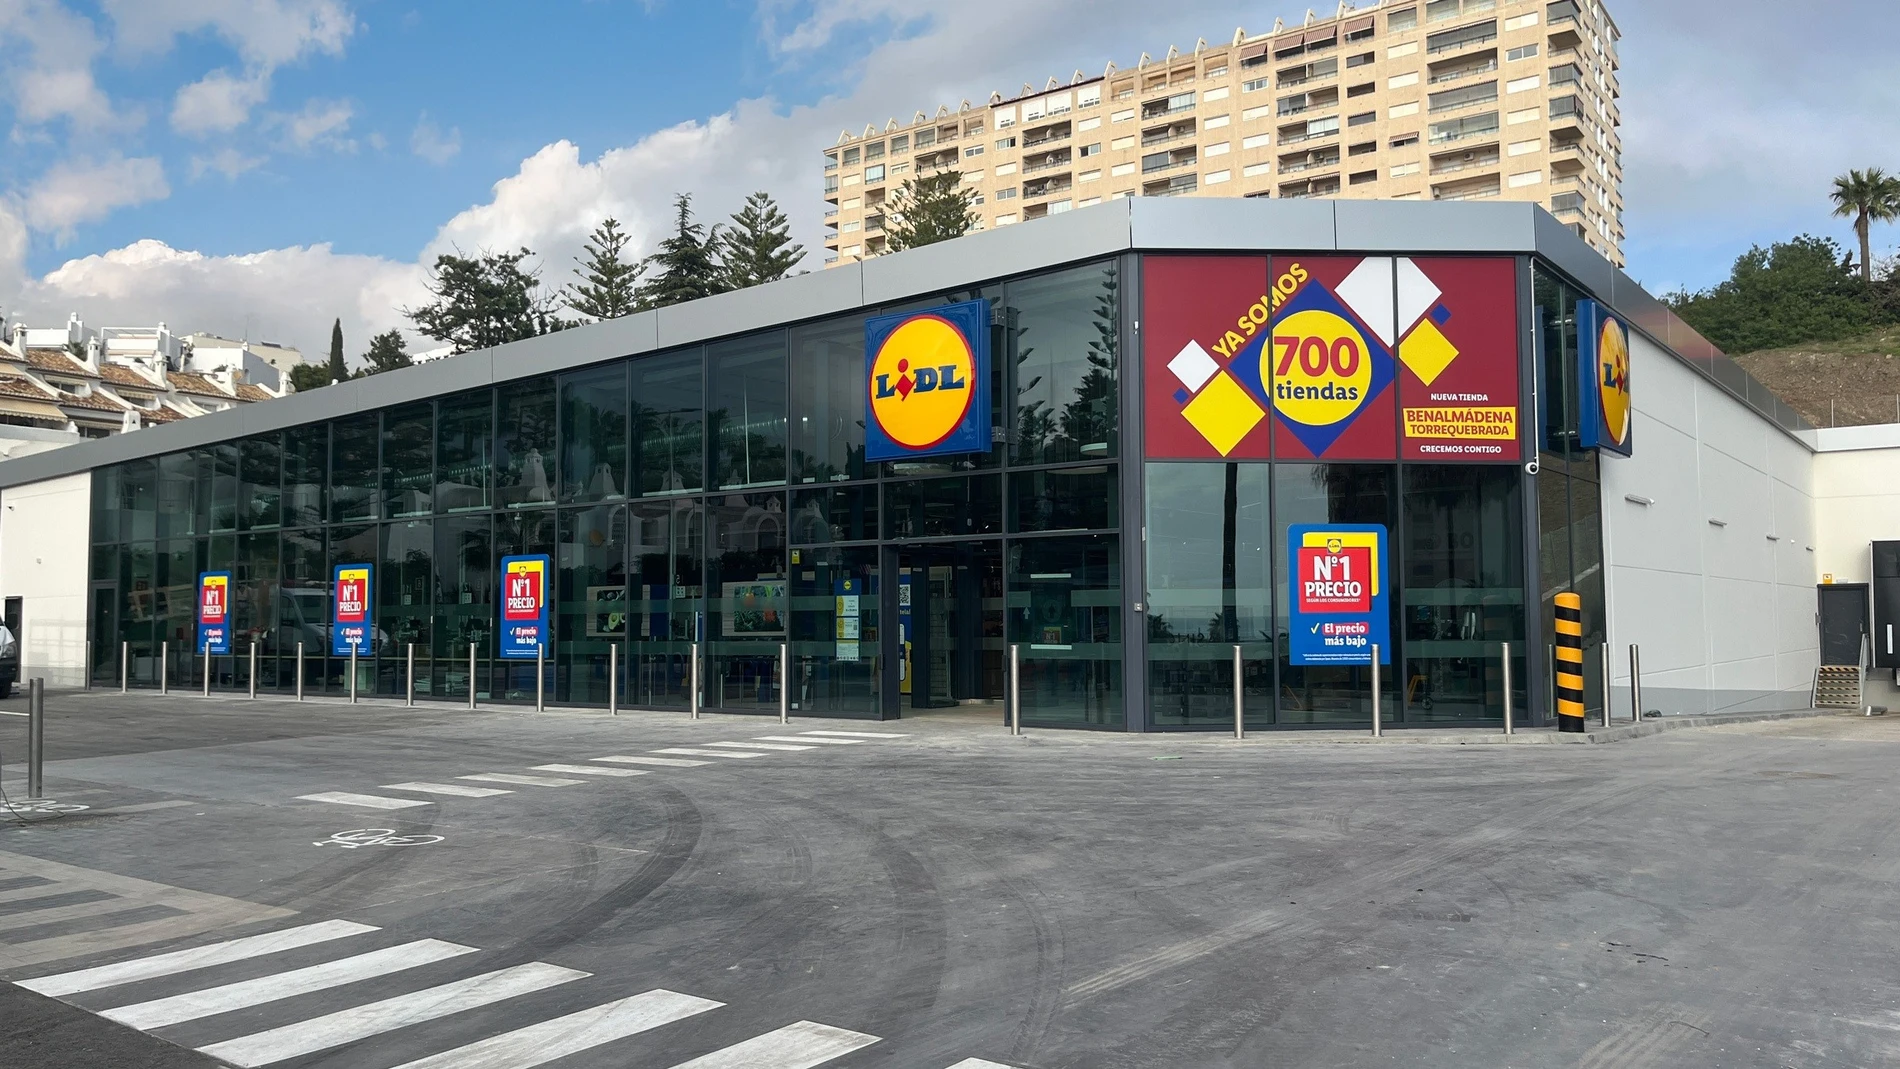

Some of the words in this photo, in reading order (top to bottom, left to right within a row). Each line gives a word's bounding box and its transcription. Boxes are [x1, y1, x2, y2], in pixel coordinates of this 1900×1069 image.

[1211, 330, 1246, 358] YA
[1237, 262, 1309, 336] SOMOS
[1273, 335, 1360, 378] 700
[1276, 380, 1358, 401] tiendas
[1430, 393, 1458, 401] NUEVA
[1406, 408, 1513, 423] BENALMÁDENA
[1410, 424, 1510, 437] TORREQUEBRADA
[1420, 445, 1463, 453] CRECEMOS
[1464, 445, 1502, 453] CONTIGO
[1305, 582, 1361, 597] PRECIO
[339, 601, 361, 612] PRECIO
[508, 598, 535, 609] PRECIO
[1324, 623, 1334, 633] El
[1335, 623, 1366, 635] precio
[1324, 636, 1344, 646] más
[1345, 635, 1367, 648] bajo
